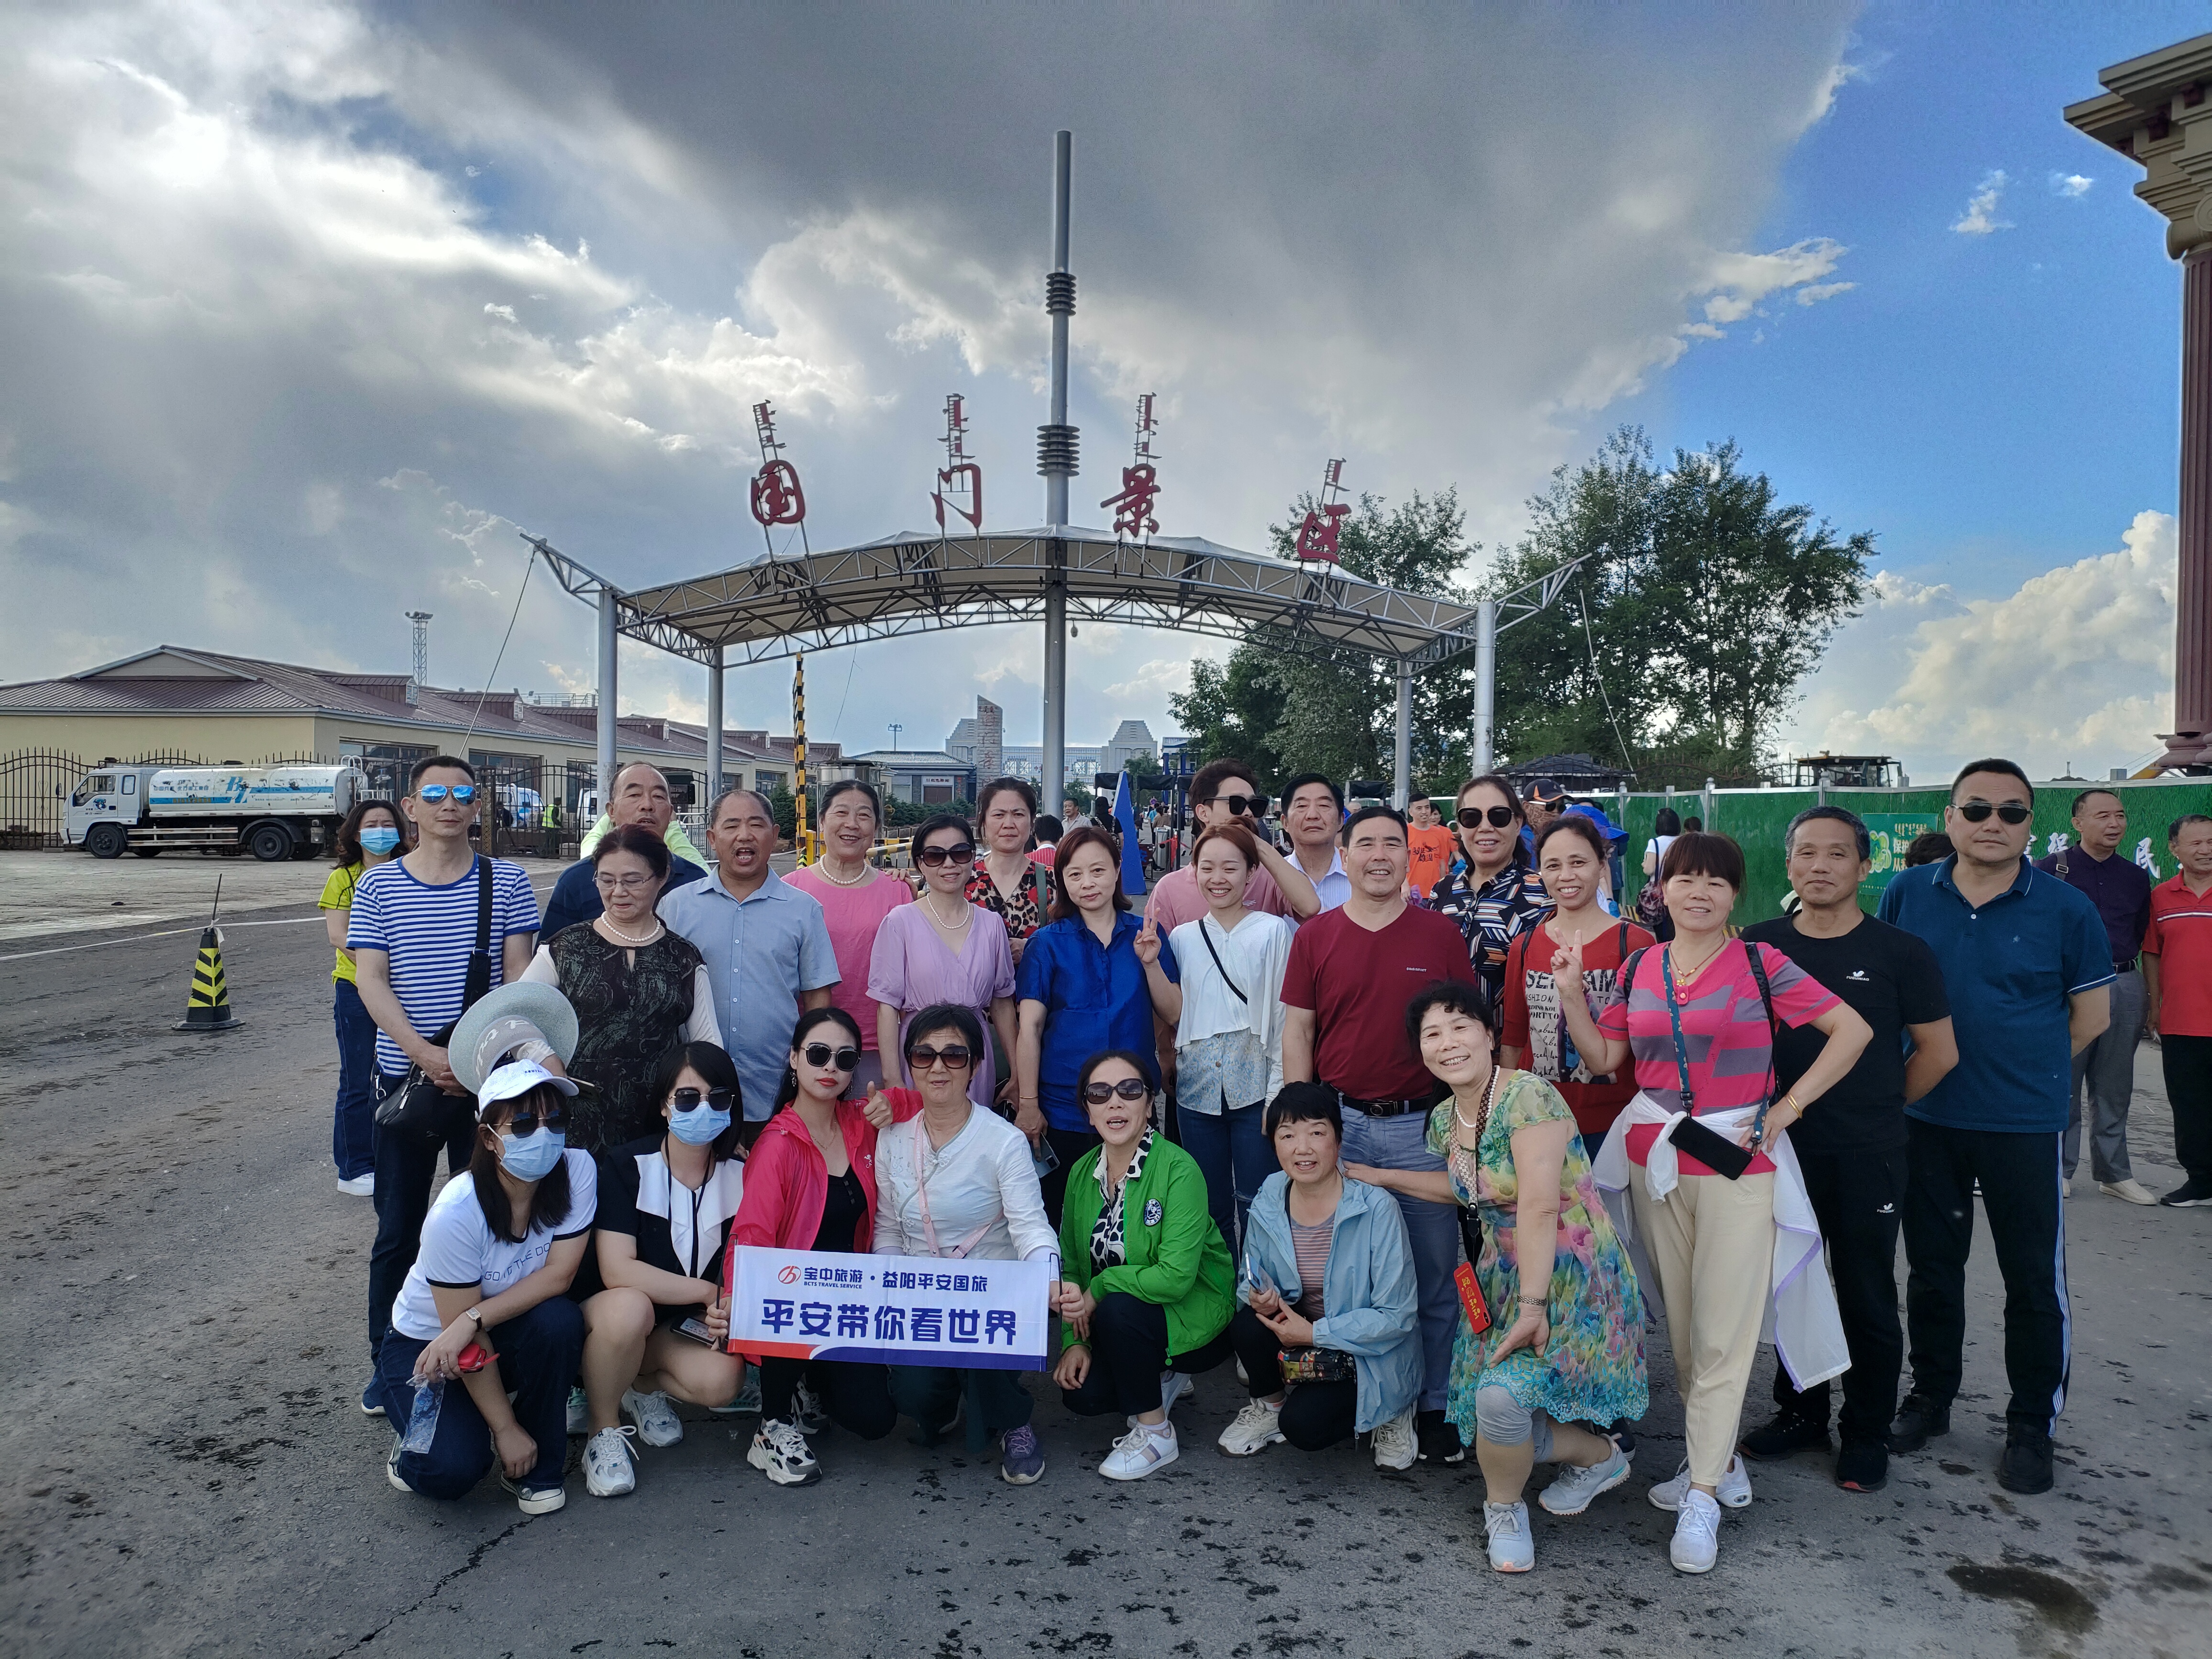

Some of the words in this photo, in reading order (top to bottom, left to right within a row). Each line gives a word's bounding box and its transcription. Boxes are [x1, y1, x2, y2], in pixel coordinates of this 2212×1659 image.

[484, 1271, 500, 1281] GO
[513, 1250, 532, 1270] THE
[804, 1267, 863, 1283] 宝中旅游
[882, 1271, 987, 1292] 益阳平安国旅
[761, 1298, 1017, 1346] 平安带你看世界
